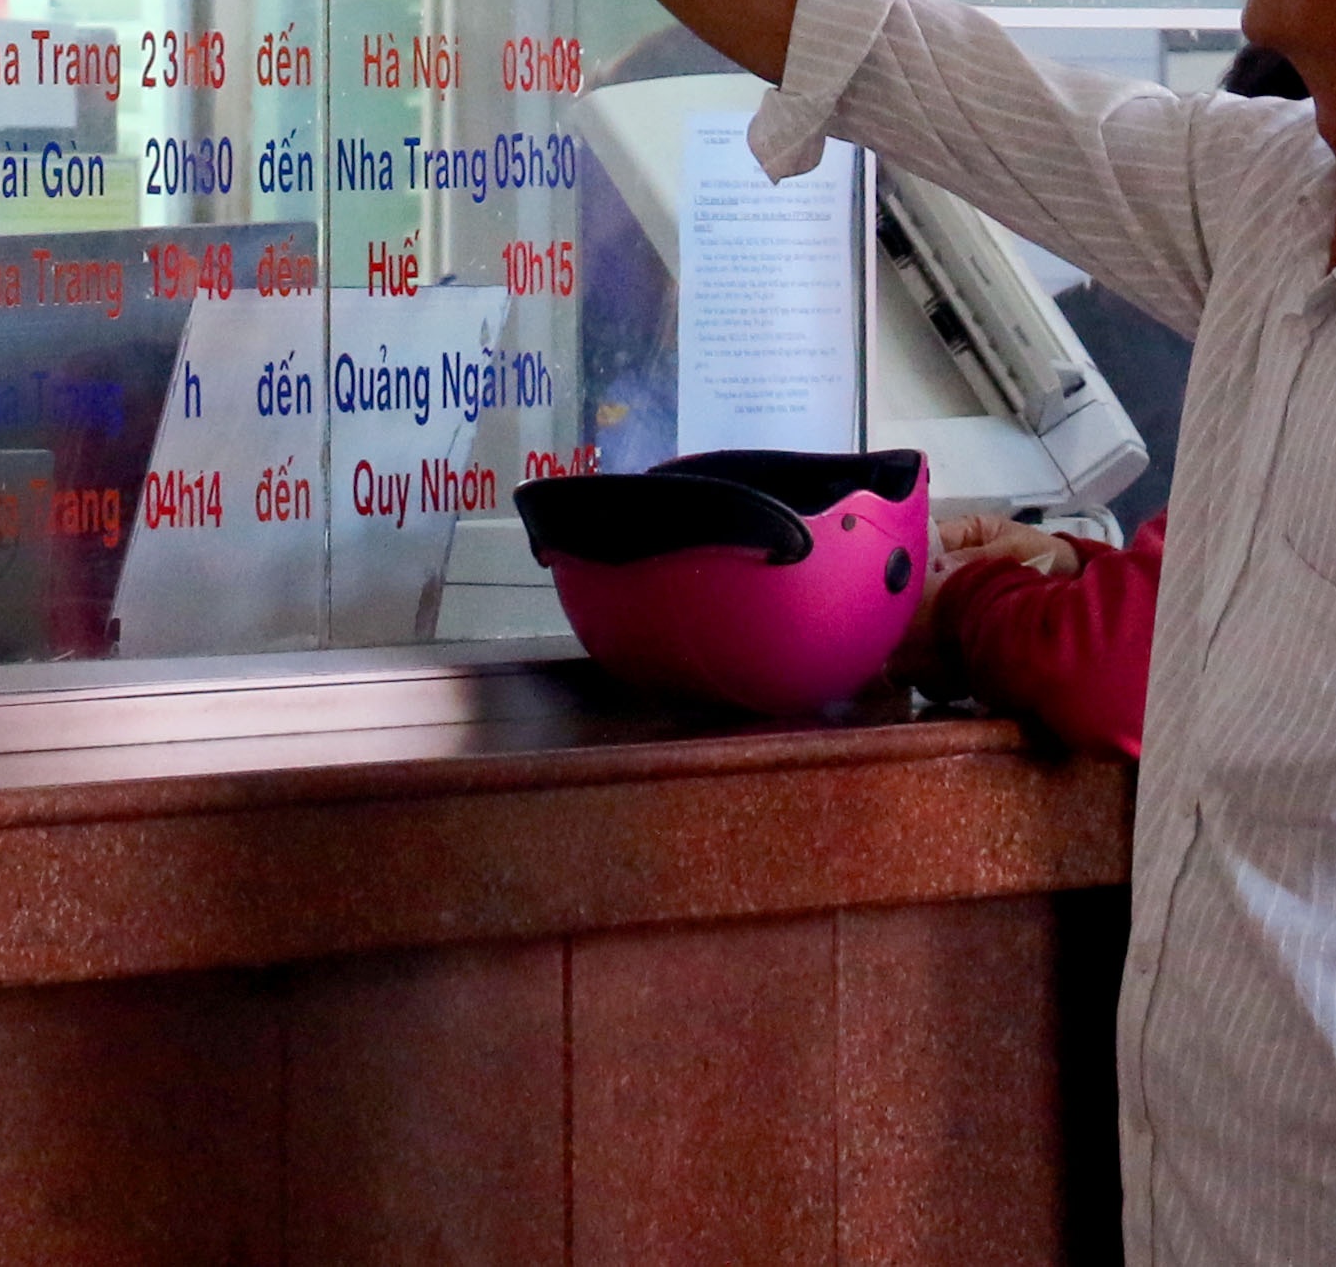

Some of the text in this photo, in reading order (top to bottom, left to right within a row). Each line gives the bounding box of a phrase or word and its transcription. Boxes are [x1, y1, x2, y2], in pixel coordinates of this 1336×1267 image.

[42, 141, 105, 198] Gòn
[145, 137, 233, 197] 20h30
[259, 128, 314, 194] đến
[337, 139, 393, 192] Nha
[402, 137, 488, 204] Trang
[495, 135, 576, 191] 05h30
